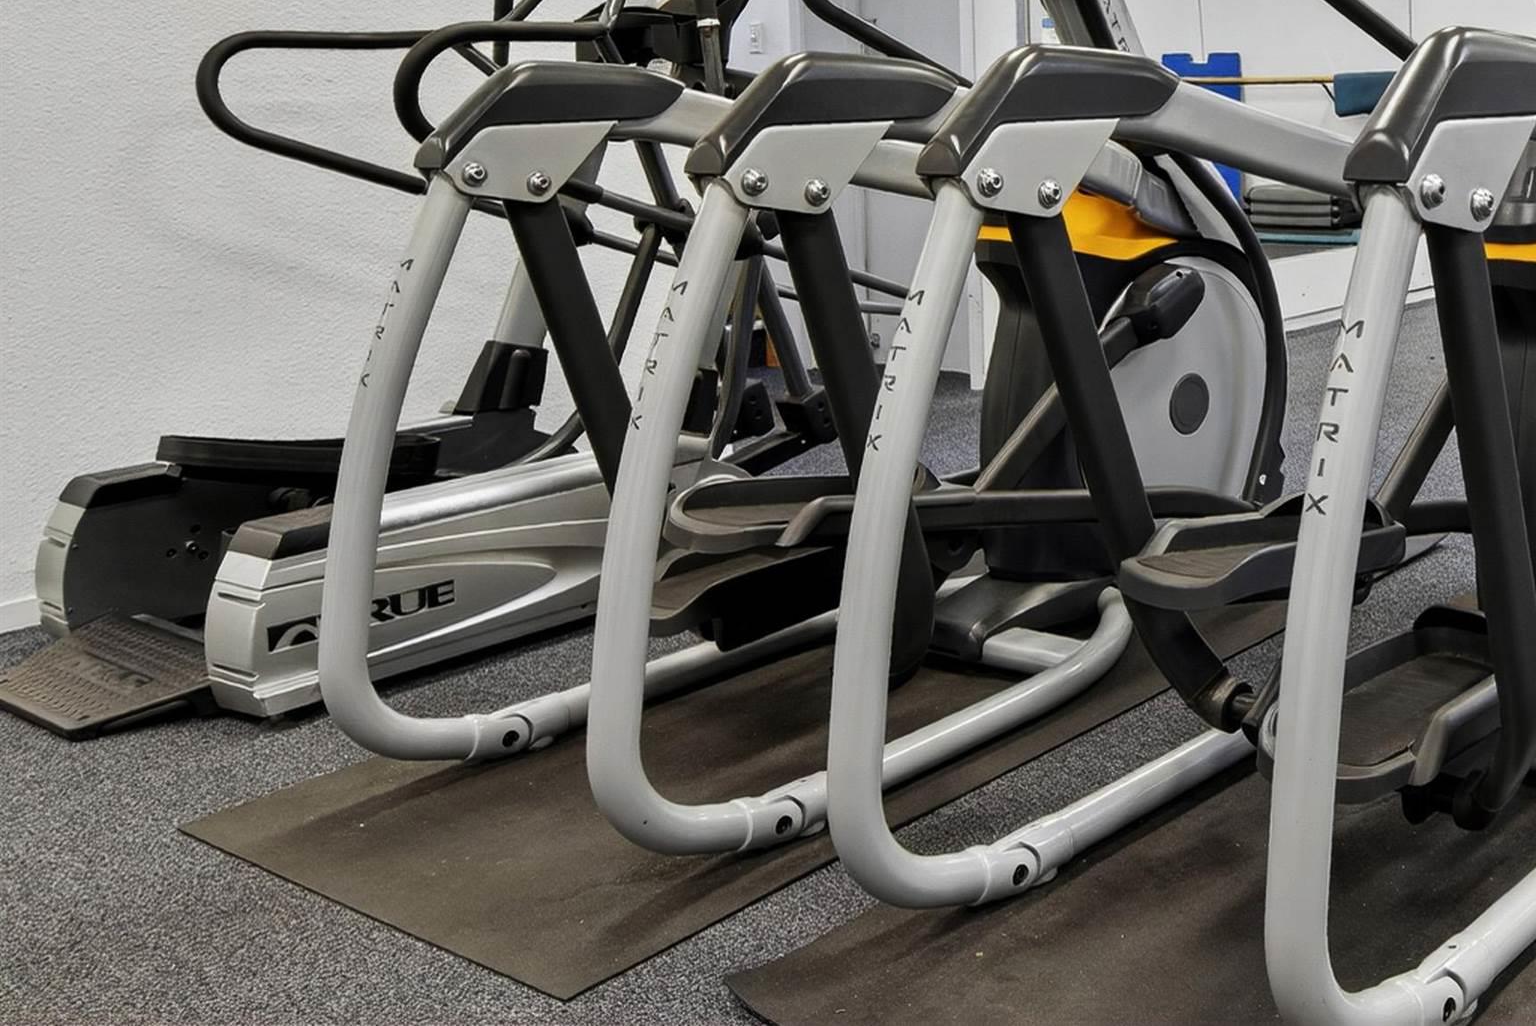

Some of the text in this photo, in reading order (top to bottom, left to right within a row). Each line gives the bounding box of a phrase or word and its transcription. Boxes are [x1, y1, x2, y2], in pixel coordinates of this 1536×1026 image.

[866, 289, 926, 452] MATRIX
[1304, 318, 1365, 516] MATRIX
[370, 579, 456, 622] RUE
